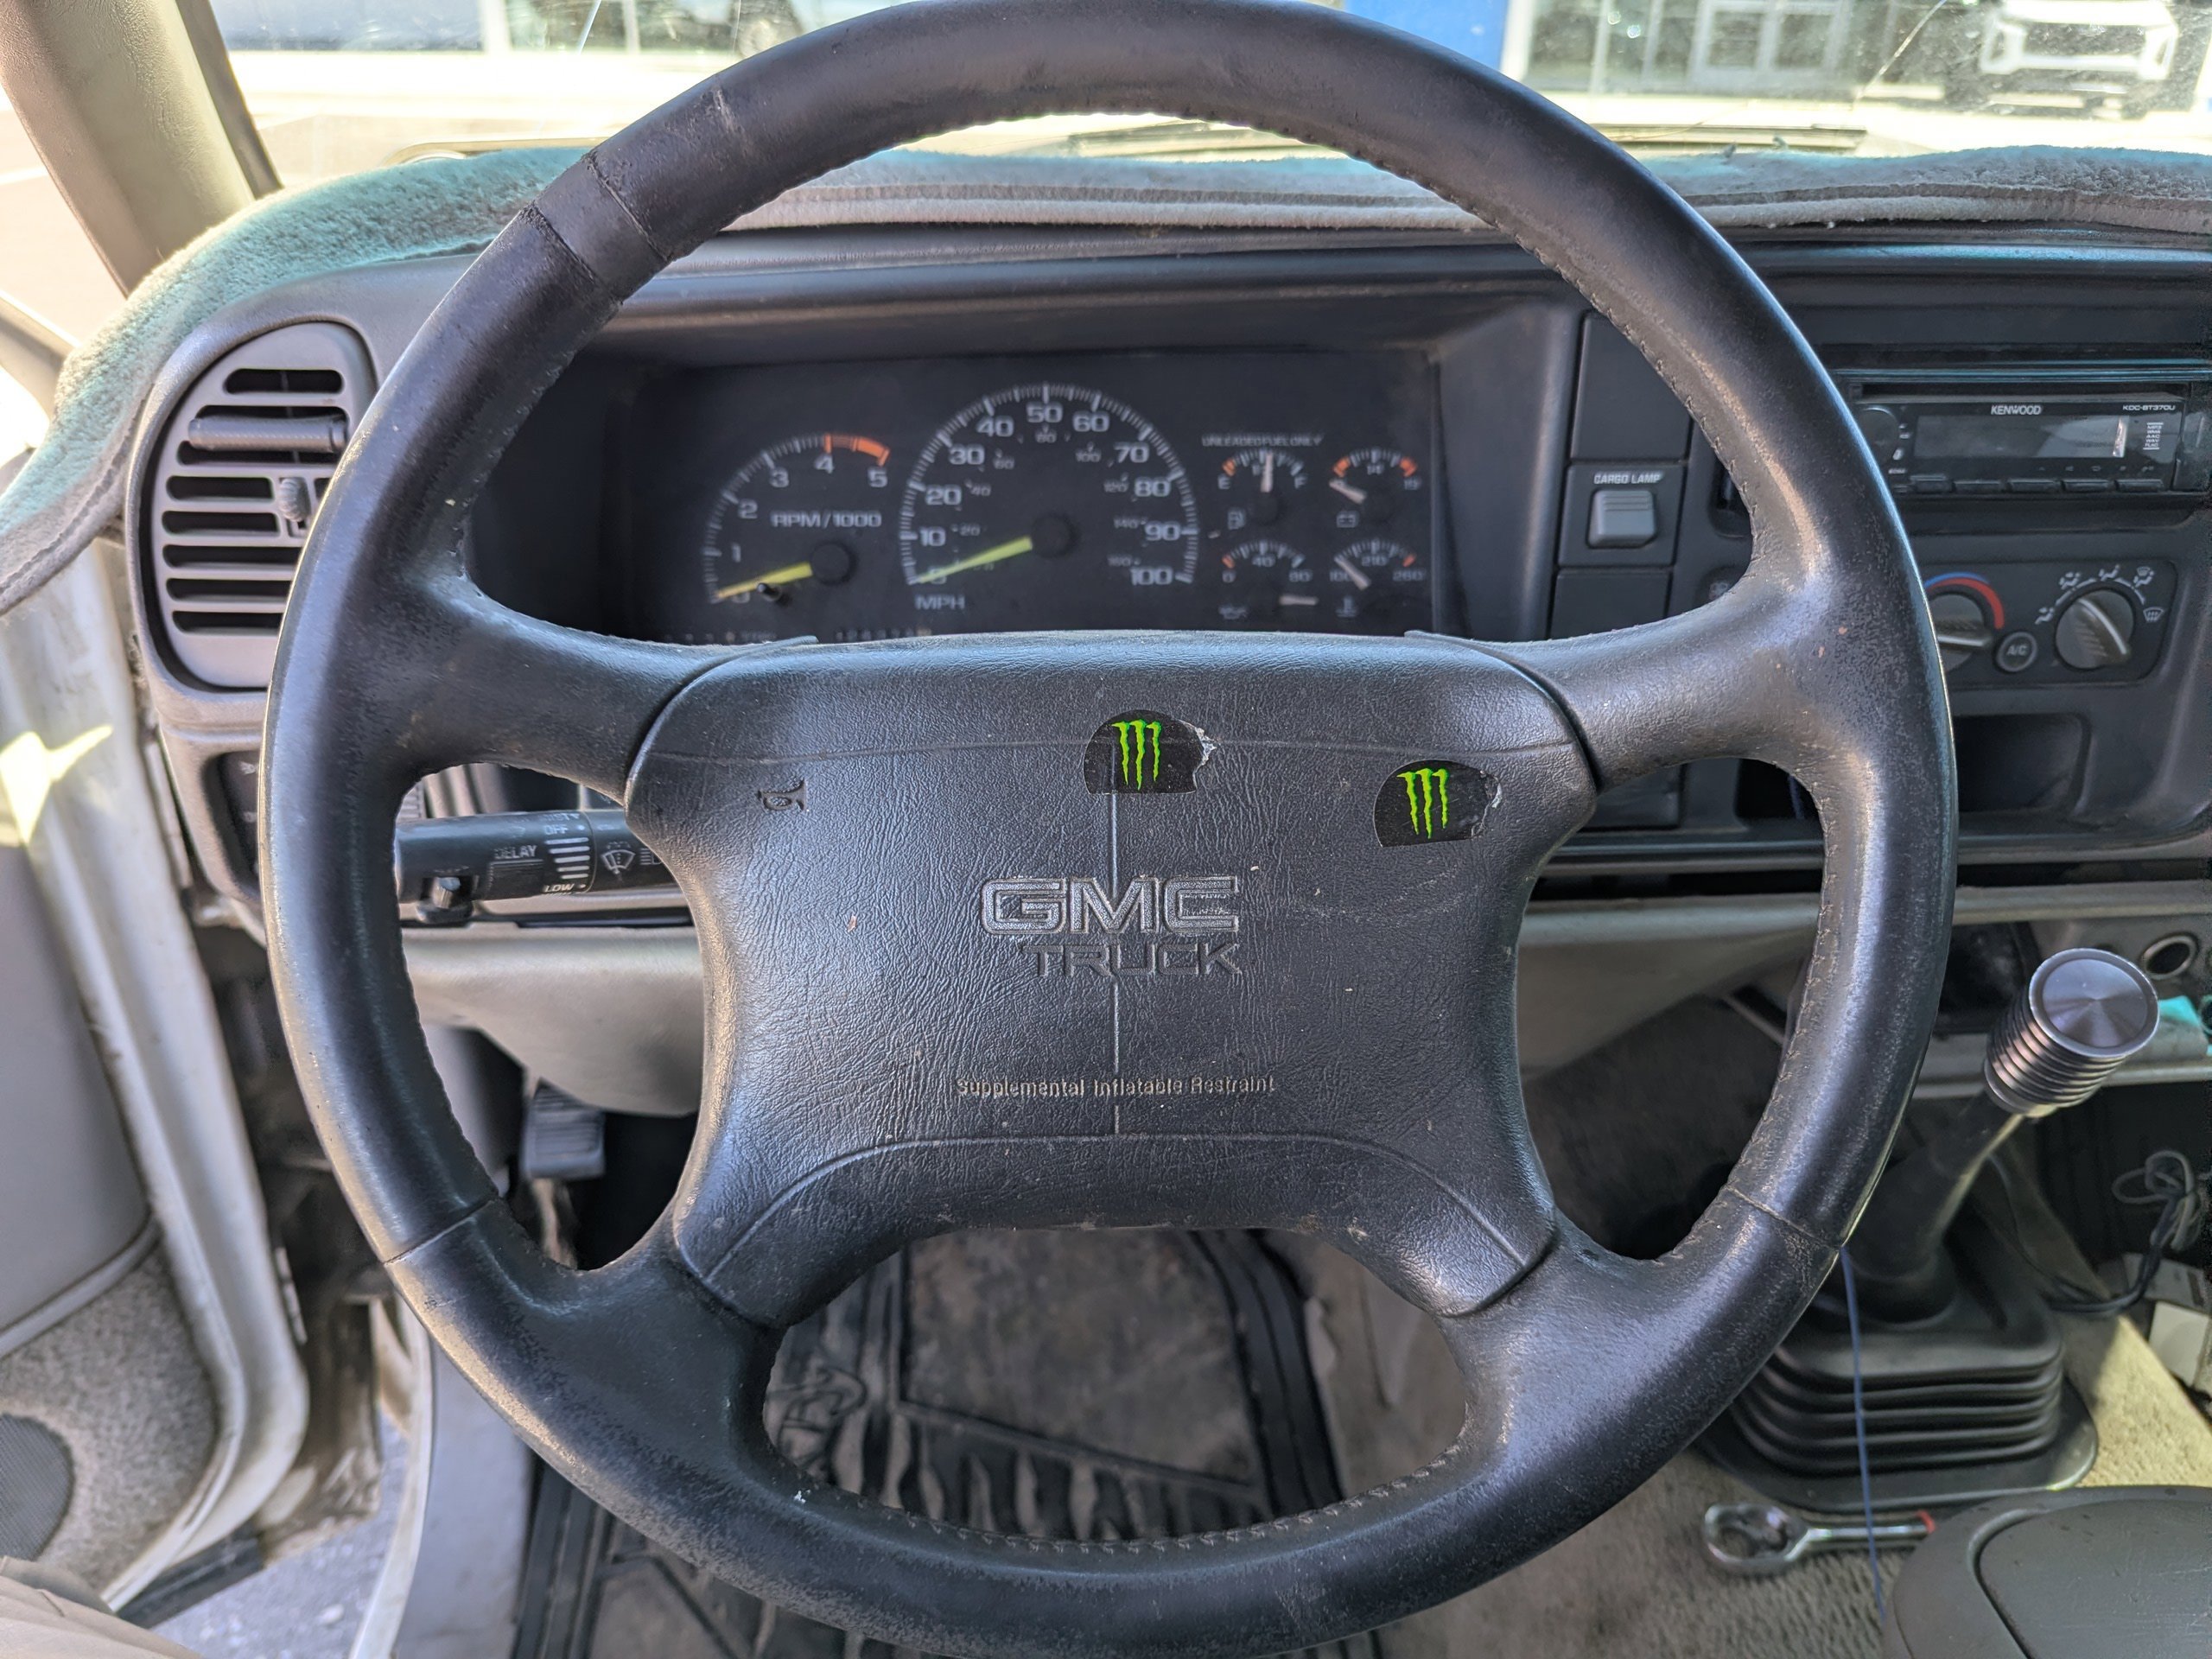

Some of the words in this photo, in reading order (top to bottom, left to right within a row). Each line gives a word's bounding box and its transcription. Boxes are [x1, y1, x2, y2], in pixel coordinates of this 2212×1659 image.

[1026, 401, 1063, 423] 50
[1991, 404, 2042, 416] KENWOOD
[976, 415, 1014, 437] 40
[1072, 411, 1110, 433] 60
[949, 443, 985, 465] 30
[1113, 442, 1150, 463] 70
[814, 453, 835, 474] 4
[768, 467, 790, 488] 3
[867, 467, 889, 488] 5
[1134, 476, 1172, 498] 80
[1217, 474, 1230, 490] E
[1294, 474, 1308, 490] F
[1593, 472, 1628, 485] CARGO
[1630, 471, 1663, 485] LAMP
[925, 484, 962, 505] 20
[738, 499, 759, 519] 2
[770, 510, 883, 529] RPM/1000
[919, 526, 946, 547] 10
[1144, 521, 1181, 542] 90
[730, 542, 742, 563] 1
[1129, 566, 1173, 586] 100
[914, 594, 966, 610] MPH
[2006, 645, 2029, 656] A/C
[543, 823, 569, 836] OFF
[493, 845, 537, 860] DELAY
[543, 883, 575, 893] LOW
[981, 874, 1241, 937] GMC
[1019, 942, 1243, 978] TRUCK
[956, 1077, 1085, 1098] Supplemental
[1093, 1077, 1183, 1098] Inflatable
[1191, 1075, 1276, 1095] Restraint
